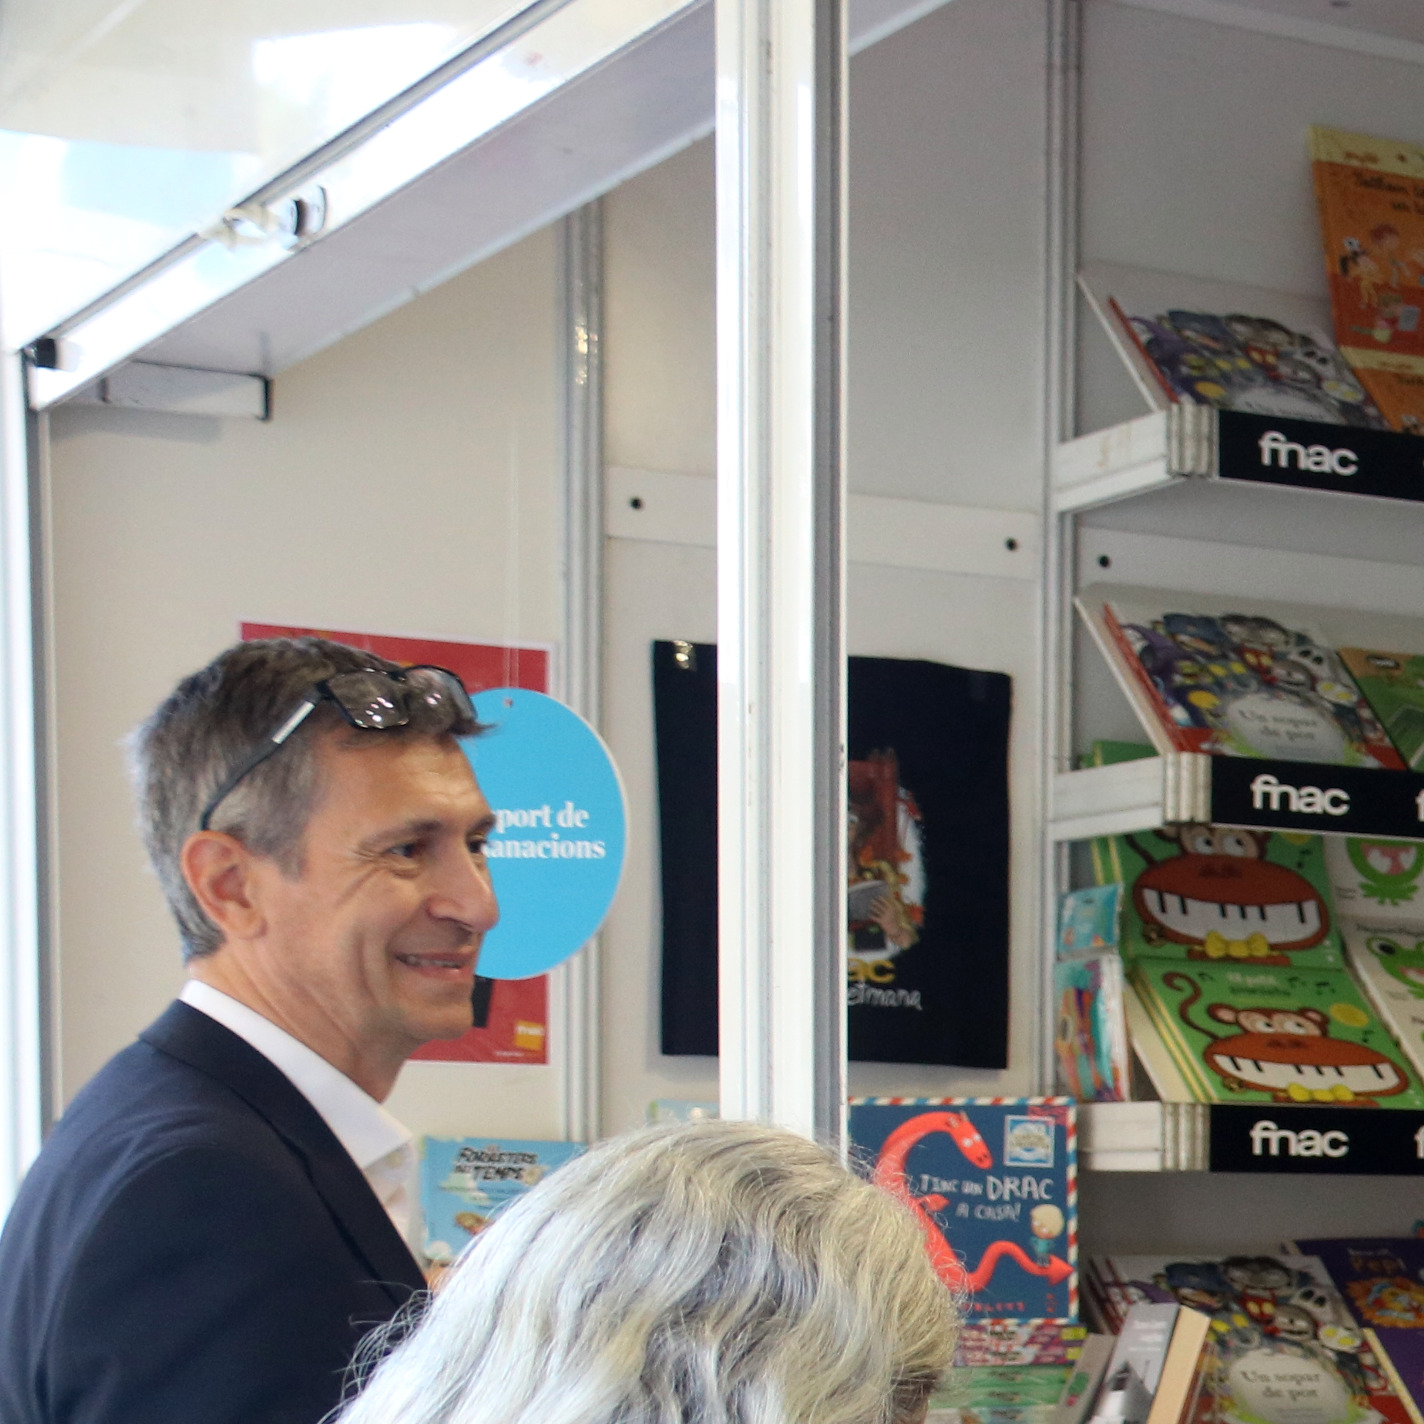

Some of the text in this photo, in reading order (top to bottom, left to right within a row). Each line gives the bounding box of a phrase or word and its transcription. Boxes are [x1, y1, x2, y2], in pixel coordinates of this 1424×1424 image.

[1259, 431, 1357, 475] fnac
[1251, 774, 1349, 815] fnac
[495, 800, 590, 834] port de
[1250, 1121, 1348, 1157] fnac
[986, 1174, 1054, 1201] DRAC
